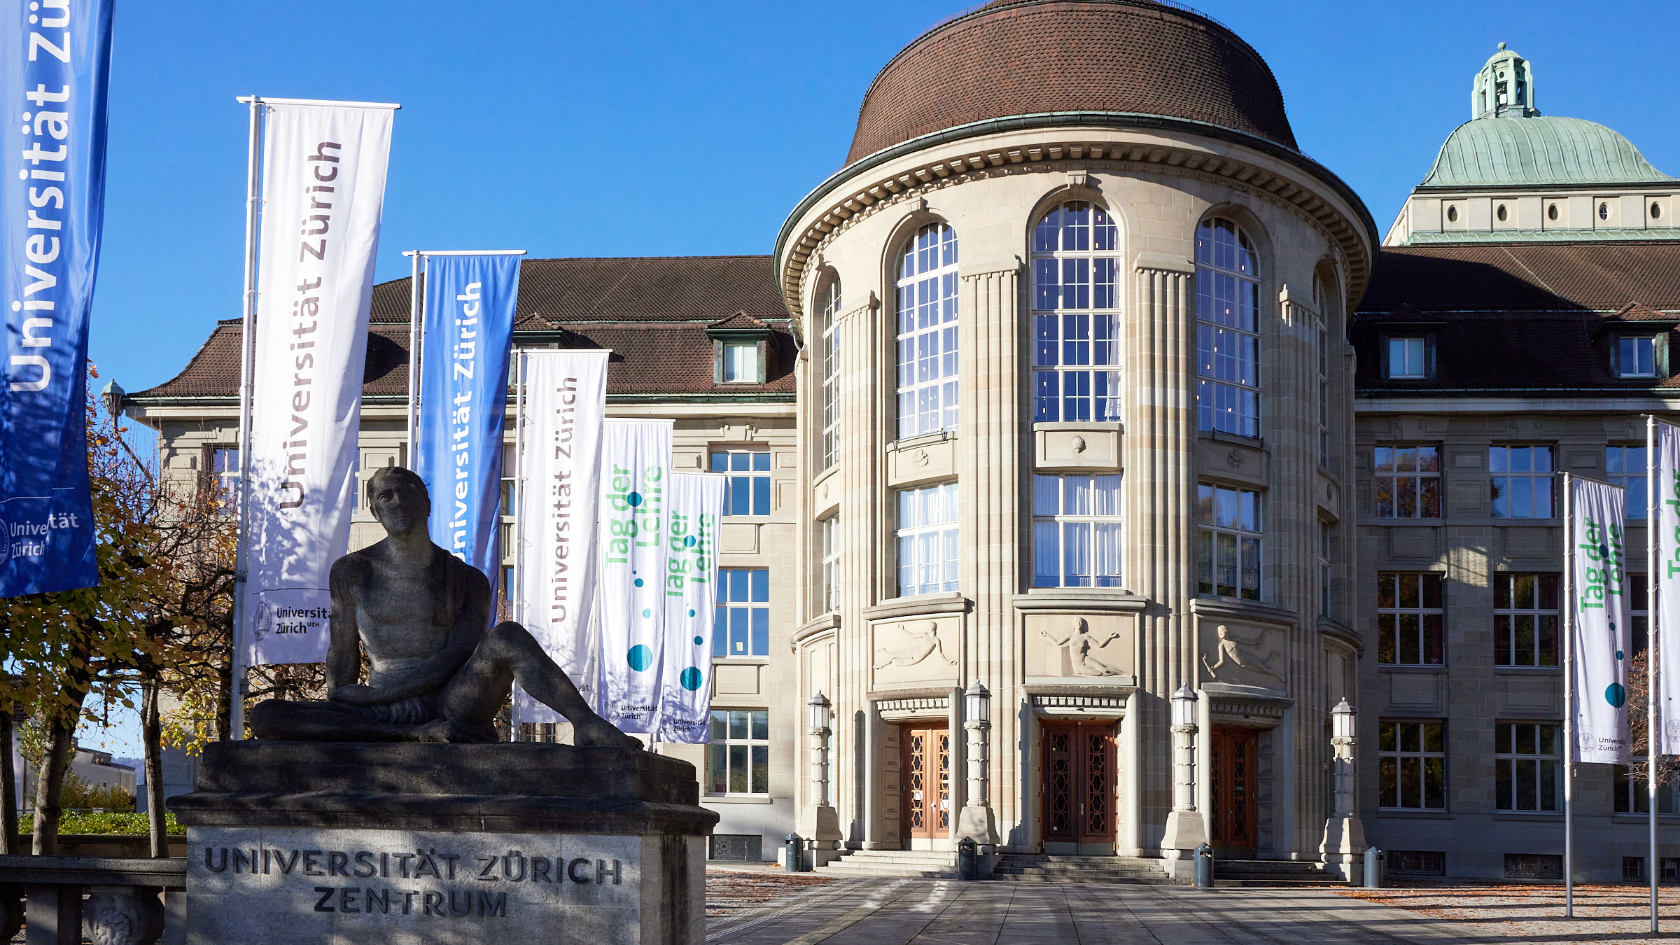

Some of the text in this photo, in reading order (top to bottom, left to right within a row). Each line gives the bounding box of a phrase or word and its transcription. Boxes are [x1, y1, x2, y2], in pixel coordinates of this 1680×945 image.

[10, 83, 70, 392] Universität
[280, 140, 342, 510] Universität Zürich
[453, 281, 482, 381] Zürich
[551, 377, 578, 623] Universität Zürich
[605, 463, 639, 569] Tag der
[635, 466, 663, 547] Lehre
[690, 513, 715, 584] Lehre
[1578, 517, 1609, 613] Tag der
[1605, 523, 1624, 597] Lehre
[205, 848, 622, 885] UNIVERSITÄT ZÜRICH
[313, 886, 508, 919] ZENTRUM
